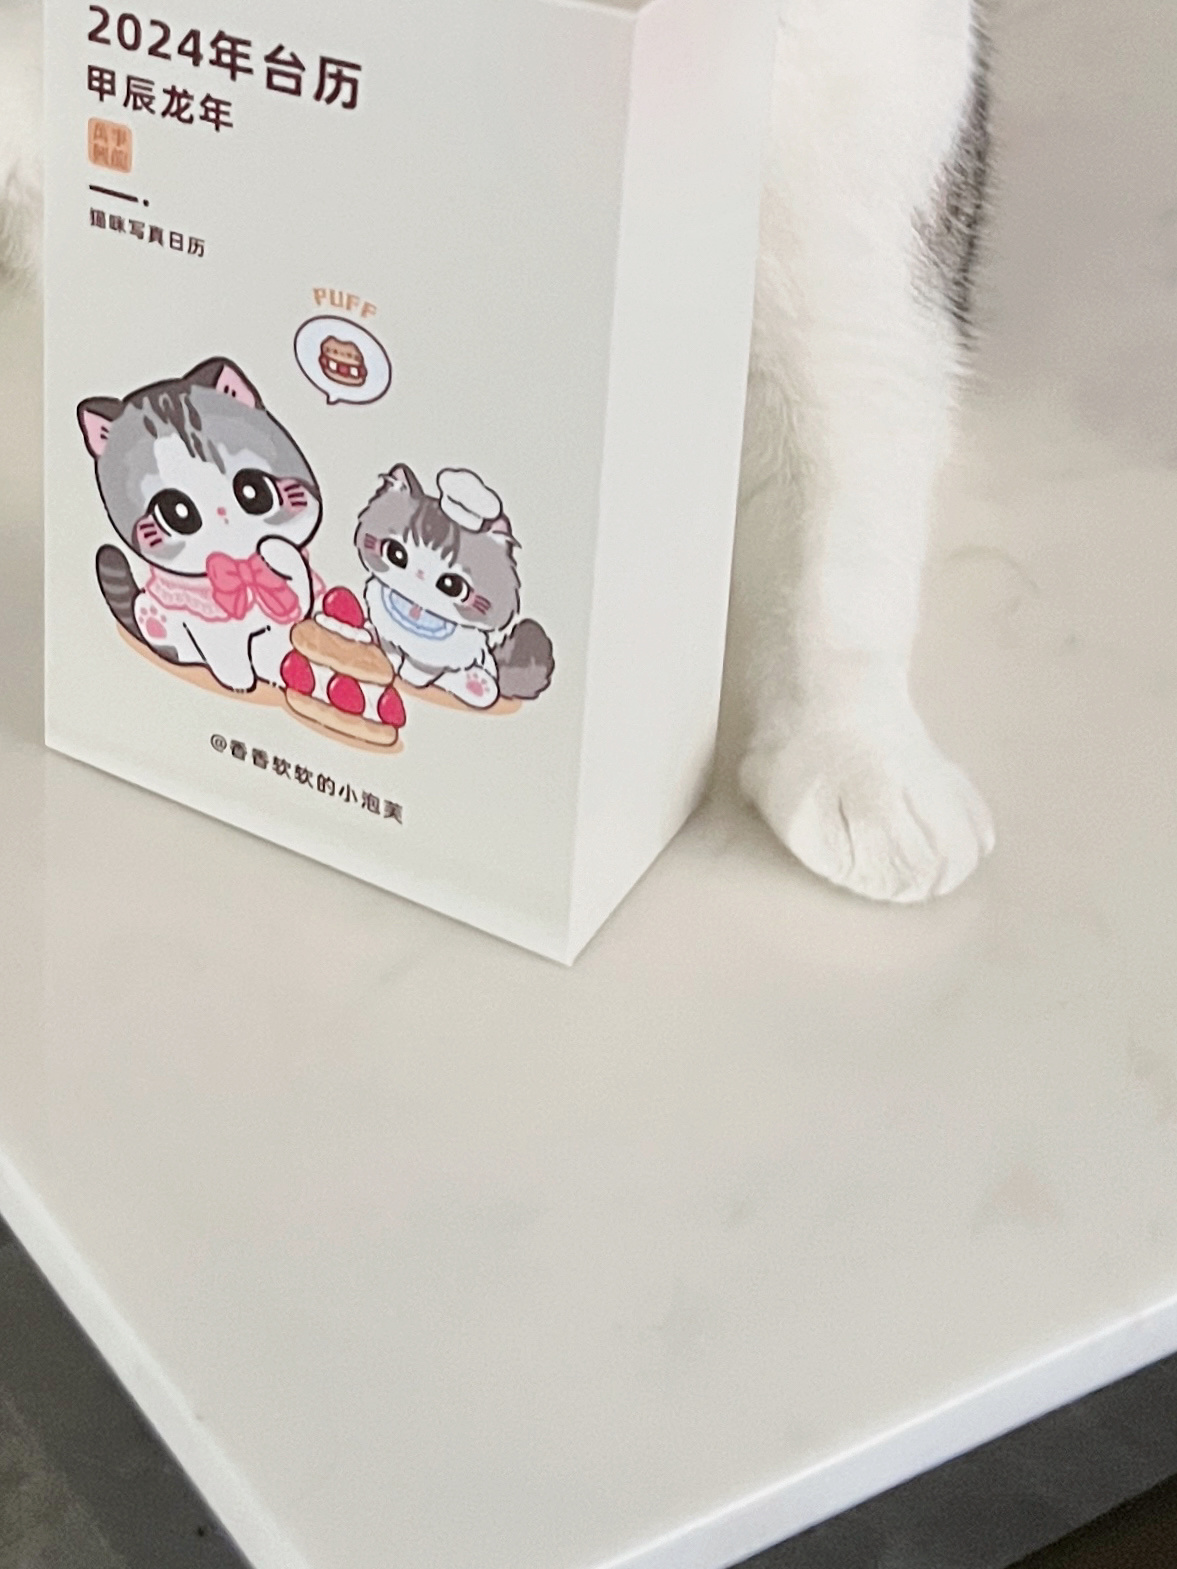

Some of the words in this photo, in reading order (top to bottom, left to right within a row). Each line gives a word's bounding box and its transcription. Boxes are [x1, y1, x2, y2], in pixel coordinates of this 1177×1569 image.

[86, 4, 362, 111] 2024年台历
[87, 64, 235, 133] 甲辰龙年
[312, 287, 378, 319] PUFF
[210, 733, 403, 824] @香香软软的小泡芙
